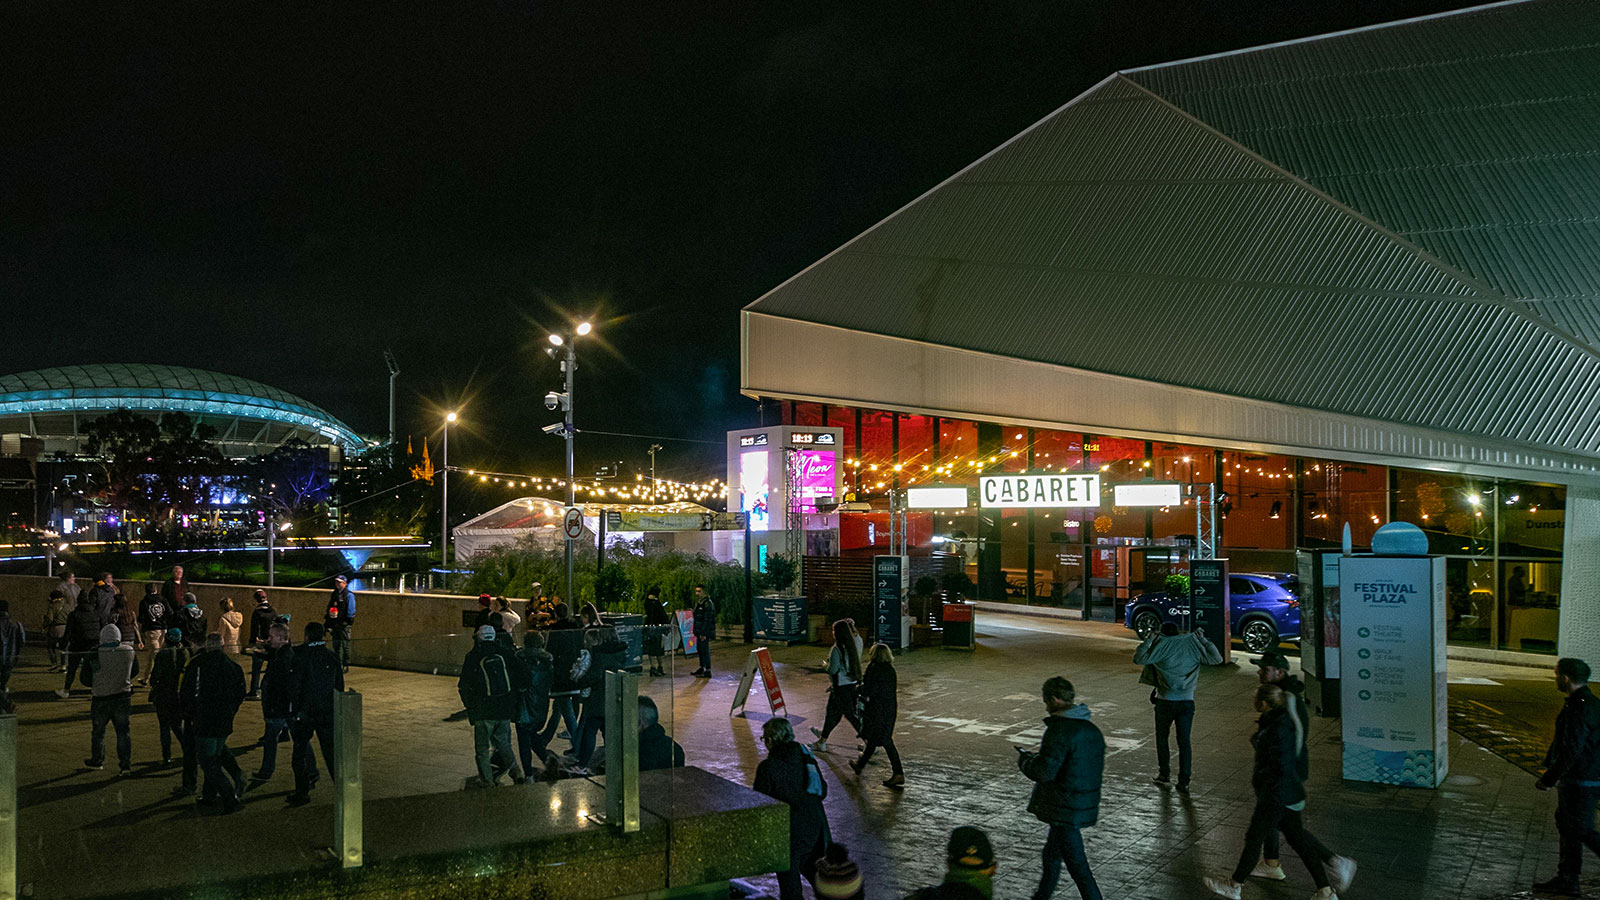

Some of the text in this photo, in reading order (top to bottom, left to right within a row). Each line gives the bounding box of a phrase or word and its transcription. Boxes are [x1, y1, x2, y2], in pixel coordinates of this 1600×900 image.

[985, 477, 1095, 503] CABARET
[1063, 519, 1080, 528] Bistro
[1354, 583, 1417, 594] FESTIVAL
[1363, 593, 1407, 604] PLAZA
